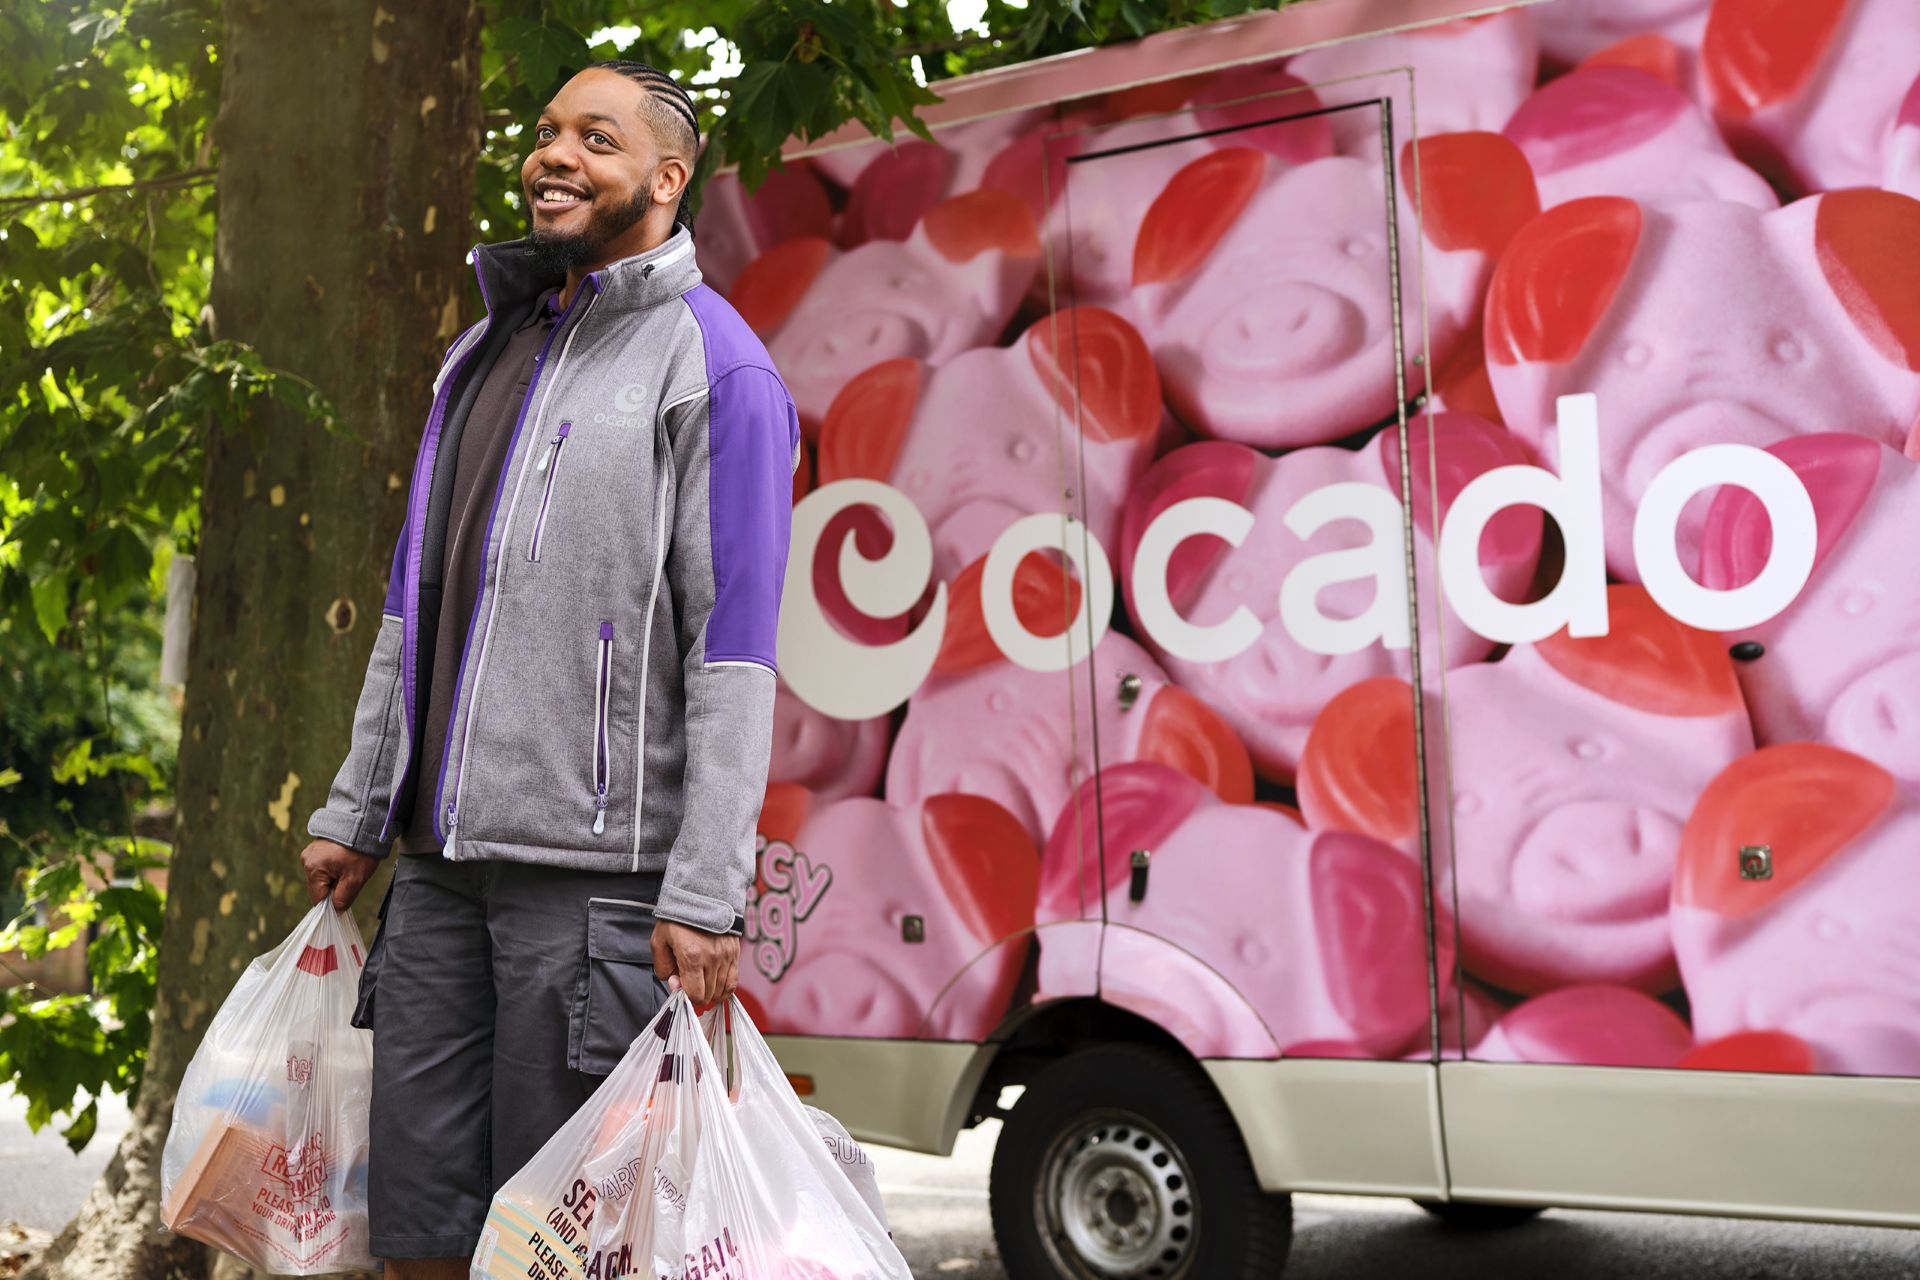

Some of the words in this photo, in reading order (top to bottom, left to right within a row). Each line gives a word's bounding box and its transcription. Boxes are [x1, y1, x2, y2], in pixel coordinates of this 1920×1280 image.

[594, 412, 648, 427] ocado
[981, 392, 1817, 672] ocado
[745, 884, 797, 982] ig
[251, 1201, 275, 1221] YOUR
[546, 1206, 578, 1245] (AND
[528, 1231, 569, 1280] PLEASE
